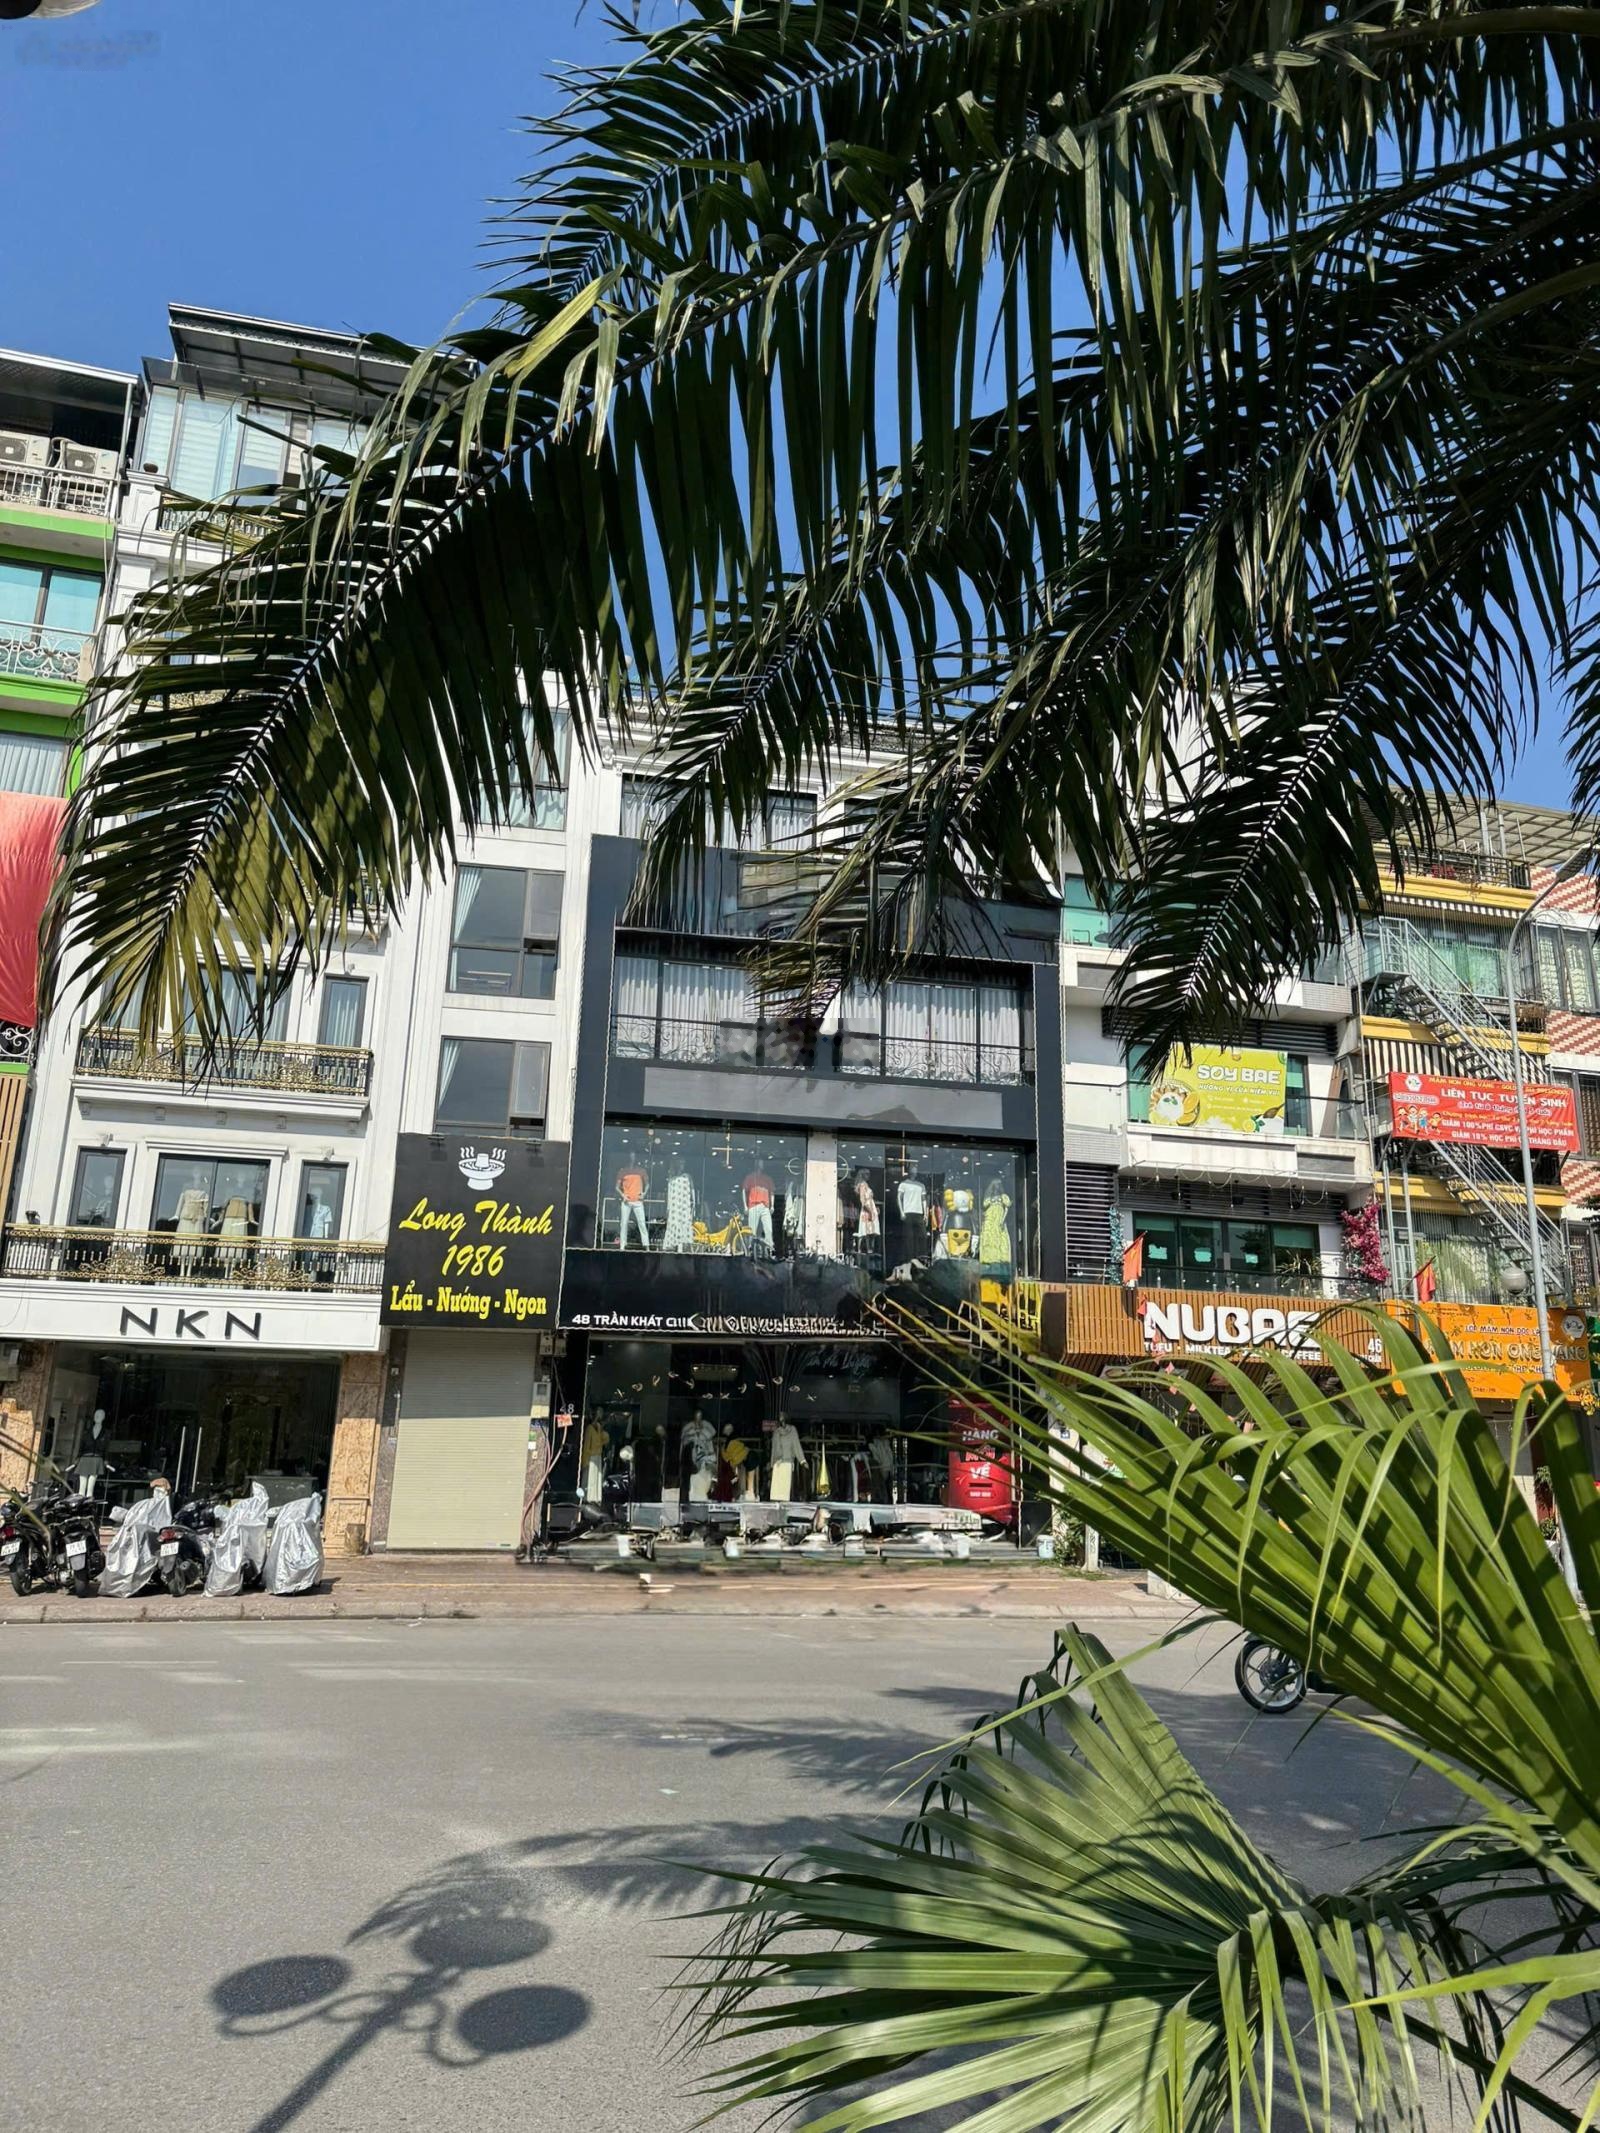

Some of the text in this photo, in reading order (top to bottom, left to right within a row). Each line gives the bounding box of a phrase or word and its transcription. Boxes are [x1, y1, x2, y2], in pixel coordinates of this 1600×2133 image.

[1197, 1064, 1280, 1085] SOY BAE
[1442, 1088, 1465, 1099] LIÊN
[1471, 1091, 1494, 1102] TỤC
[1540, 1098, 1567, 1108] SINH
[399, 1197, 554, 1241] Long Thành
[441, 1244, 507, 1276] 1986
[390, 1280, 423, 1311] Lẩu
[436, 1286, 491, 1319] Nướng
[504, 1289, 547, 1320] Ngon
[119, 1306, 261, 1340] NKN
[572, 1314, 589, 1325] 48
[594, 1311, 627, 1327] TRẦN
[631, 1312, 663, 1327] KHÁT
[1143, 1302, 1321, 1349] NUBAE
[1368, 1338, 1382, 1353] 46
